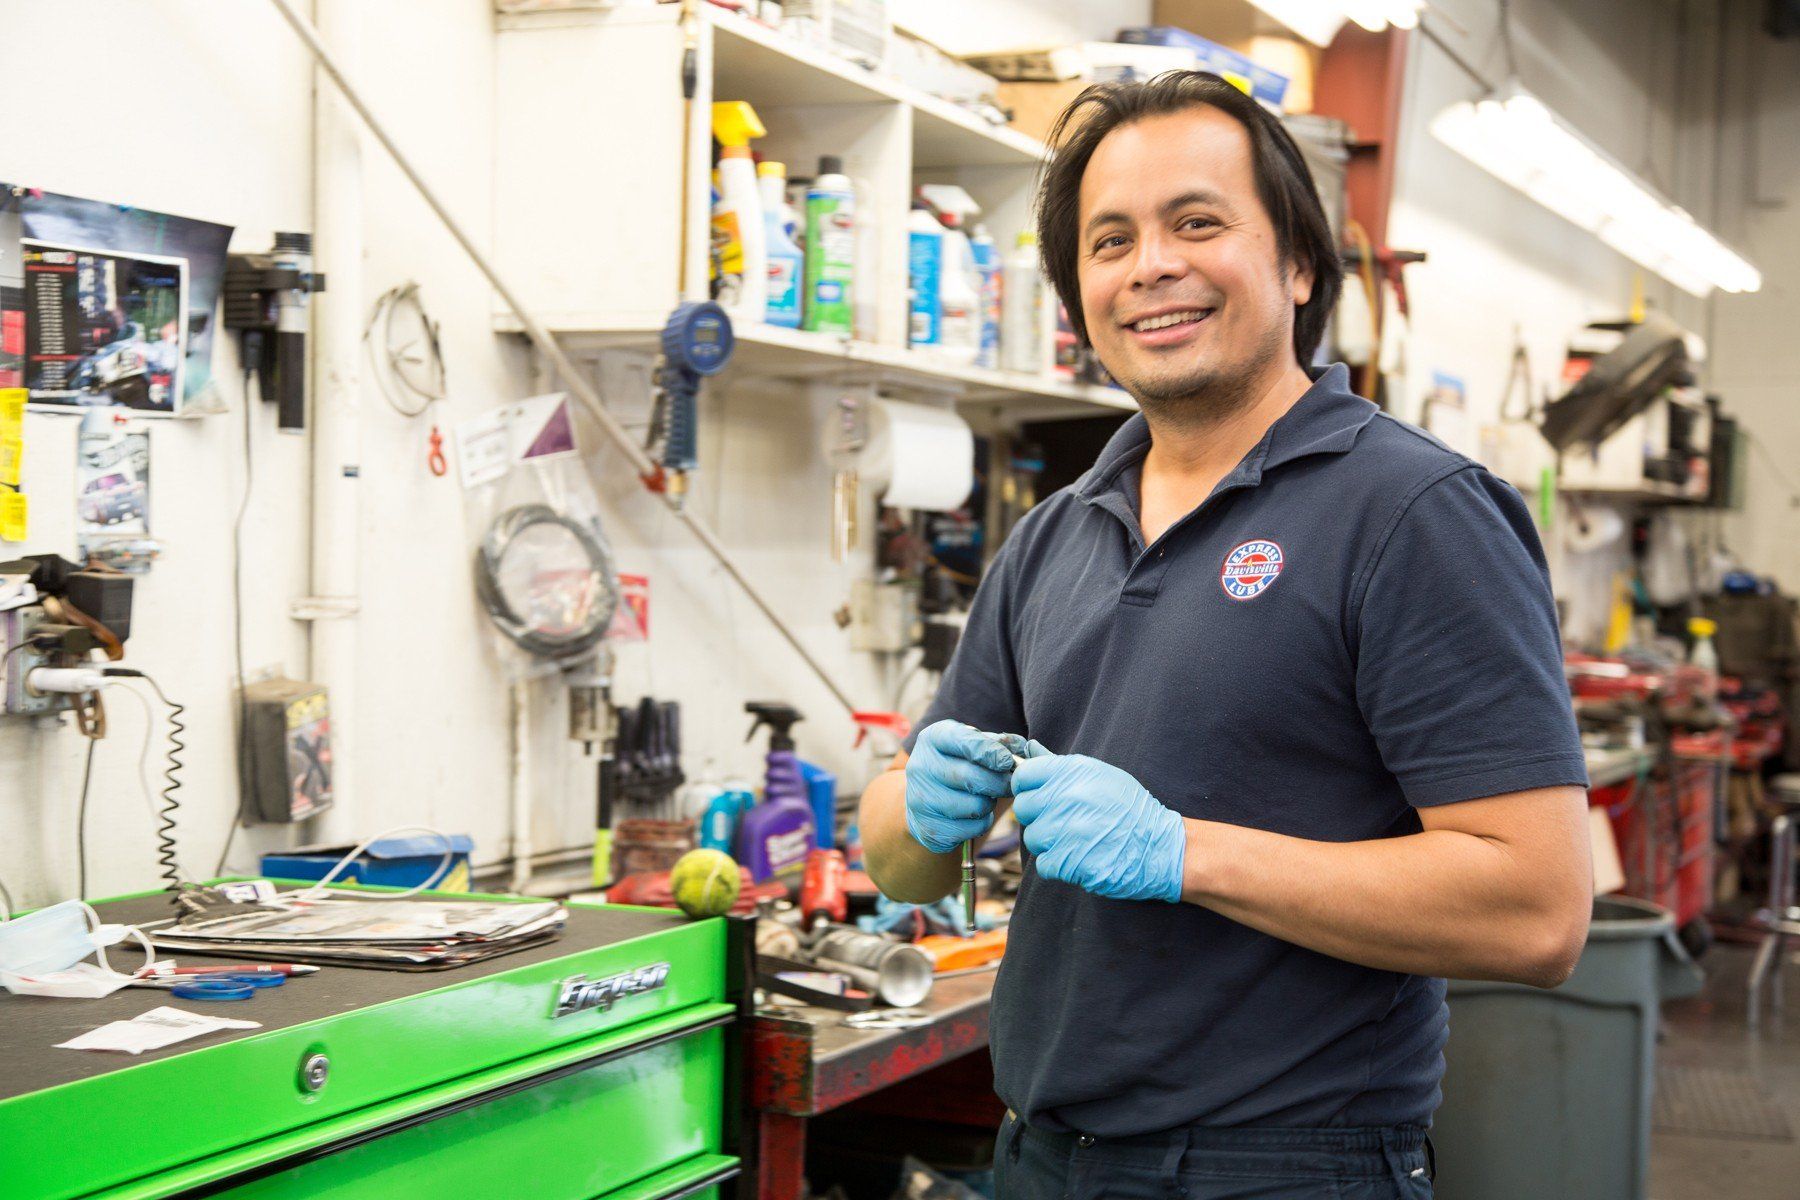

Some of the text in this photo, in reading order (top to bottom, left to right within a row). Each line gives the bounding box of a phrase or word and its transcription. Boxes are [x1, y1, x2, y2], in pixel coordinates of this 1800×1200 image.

[1231, 544, 1279, 563] EXPRESS
[1225, 563, 1279, 575] Davisville
[1229, 581, 1265, 595] LUBE
